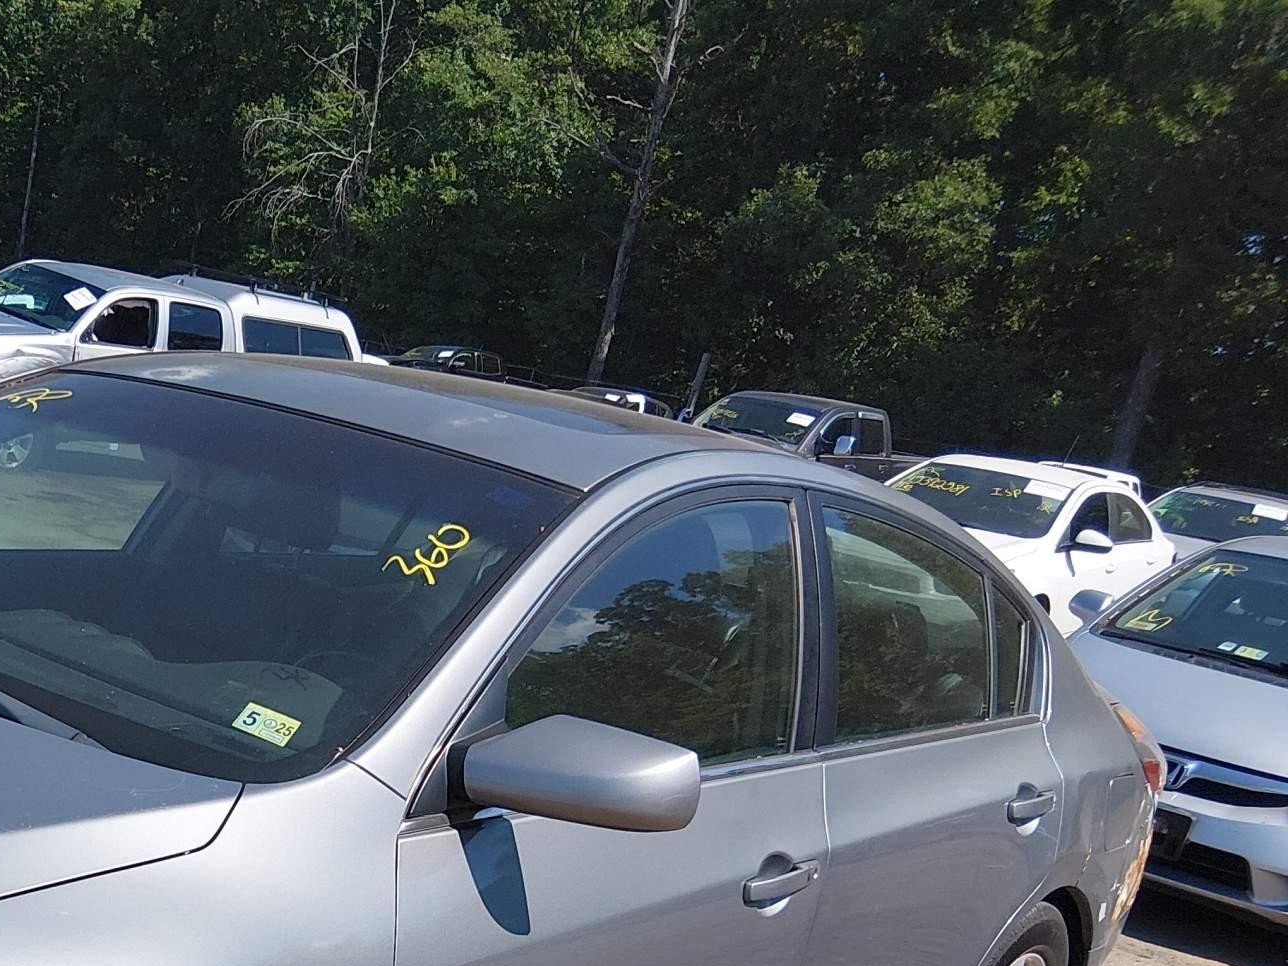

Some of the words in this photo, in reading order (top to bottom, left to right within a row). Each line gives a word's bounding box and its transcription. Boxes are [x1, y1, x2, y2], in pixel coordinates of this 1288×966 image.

[381, 522, 471, 586] 360
[242, 710, 261, 727] 5
[275, 722, 295, 737] 25
